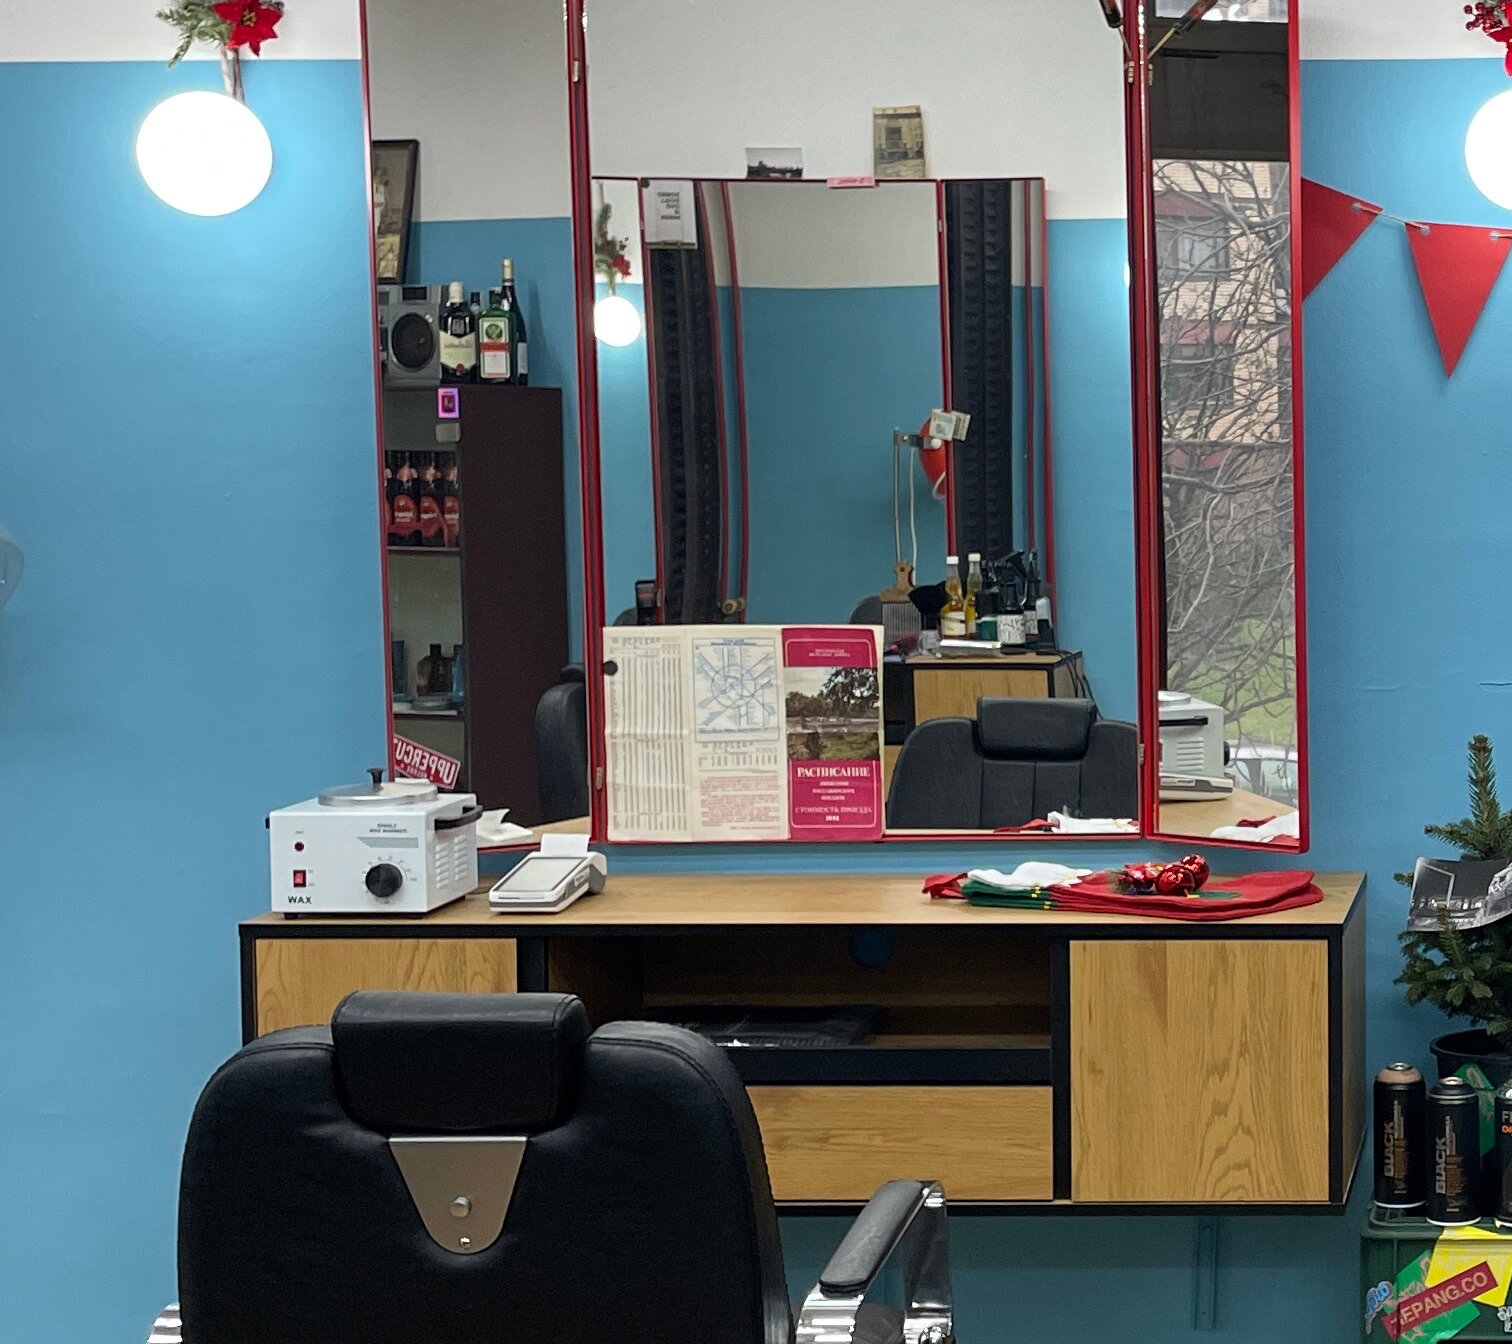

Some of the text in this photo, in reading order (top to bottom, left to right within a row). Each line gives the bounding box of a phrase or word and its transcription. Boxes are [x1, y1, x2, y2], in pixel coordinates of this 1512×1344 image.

[797, 766, 871, 777] РАСПИСАНИЕ
[288, 896, 312, 904] WAX
[1384, 1121, 1394, 1177] BLACK
[1435, 1136, 1446, 1194] BLACK
